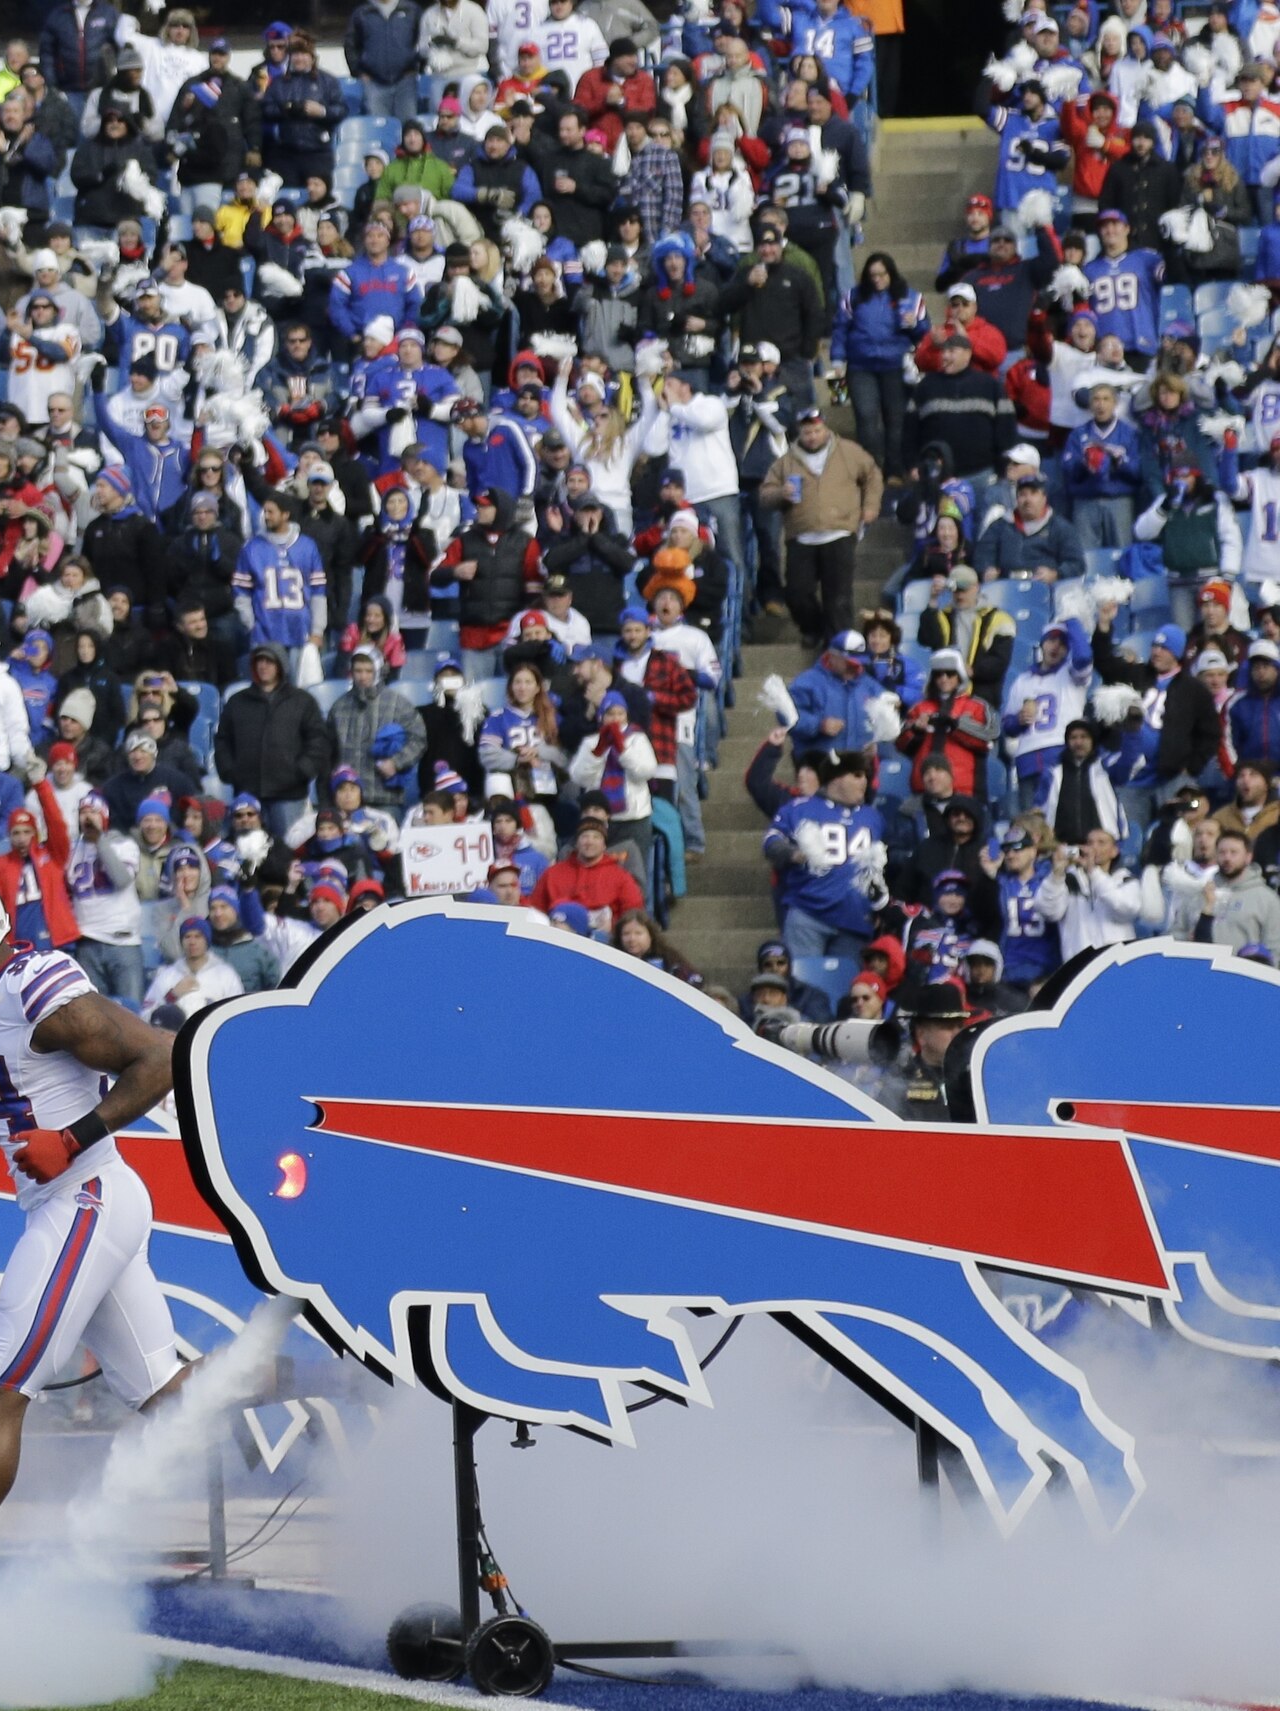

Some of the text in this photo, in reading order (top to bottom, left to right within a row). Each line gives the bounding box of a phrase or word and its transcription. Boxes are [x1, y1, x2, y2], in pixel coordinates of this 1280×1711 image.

[546, 31, 578, 64] 22
[804, 28, 835, 58] 14
[774, 174, 815, 208] 21
[1096, 271, 1139, 316] 99
[264, 567, 304, 610] 13
[453, 834, 490, 867] 9-0
[822, 823, 872, 866] 94
